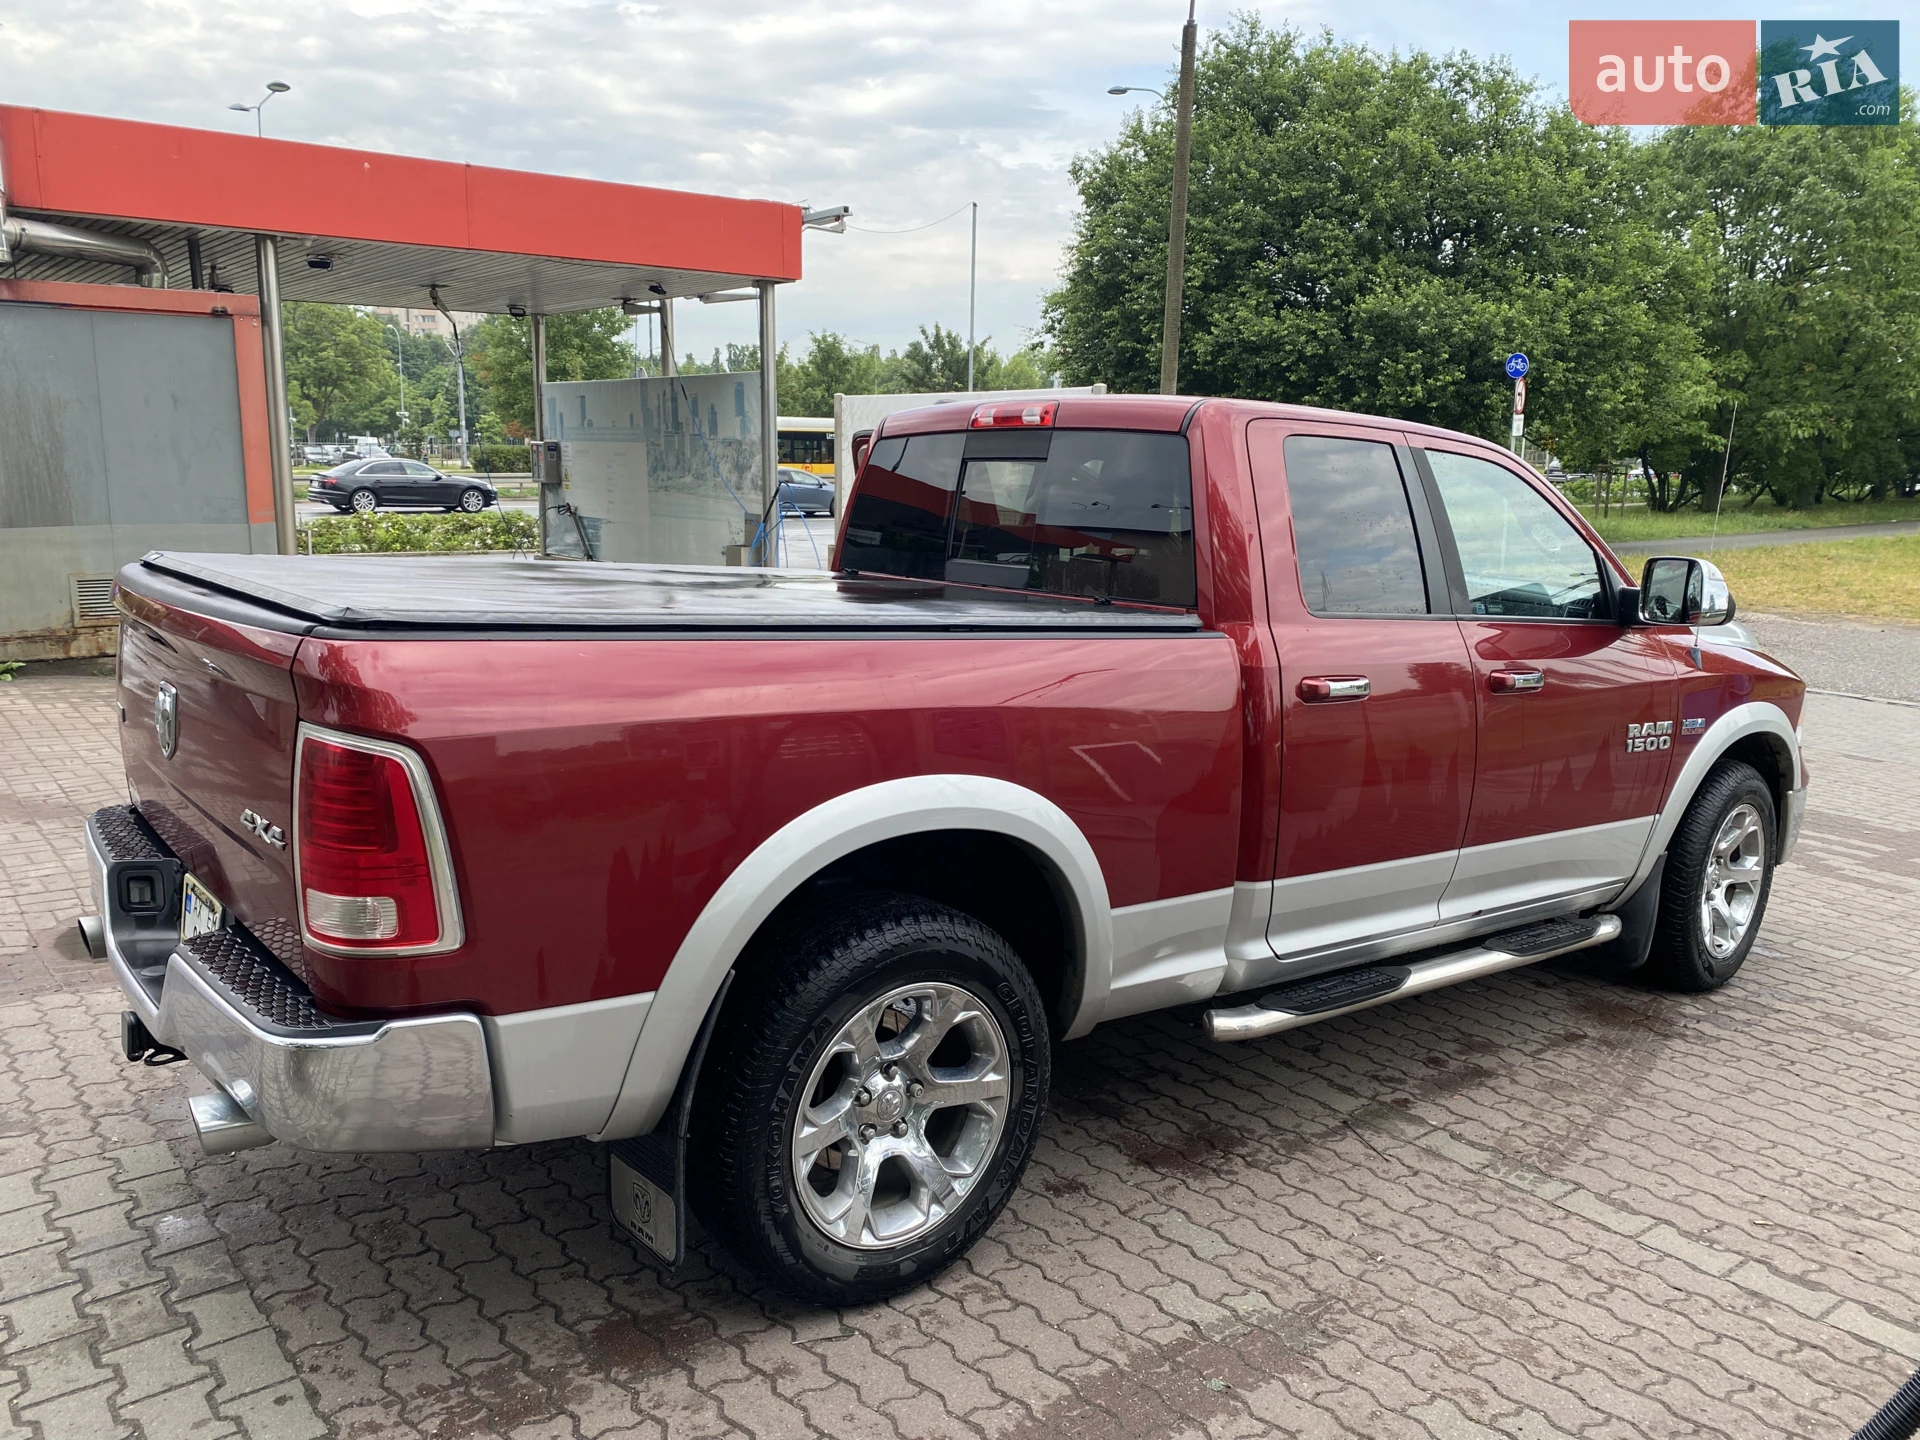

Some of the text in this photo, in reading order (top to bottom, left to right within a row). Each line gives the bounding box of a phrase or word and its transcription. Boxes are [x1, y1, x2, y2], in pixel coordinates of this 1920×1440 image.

[1627, 720, 1673, 738] RAM
[1625, 736, 1671, 753] 1500
[995, 981, 1040, 1190] GEOLANDAR
[766, 1015, 833, 1219] YOKOHAMA
[630, 1220, 655, 1244] RAM
